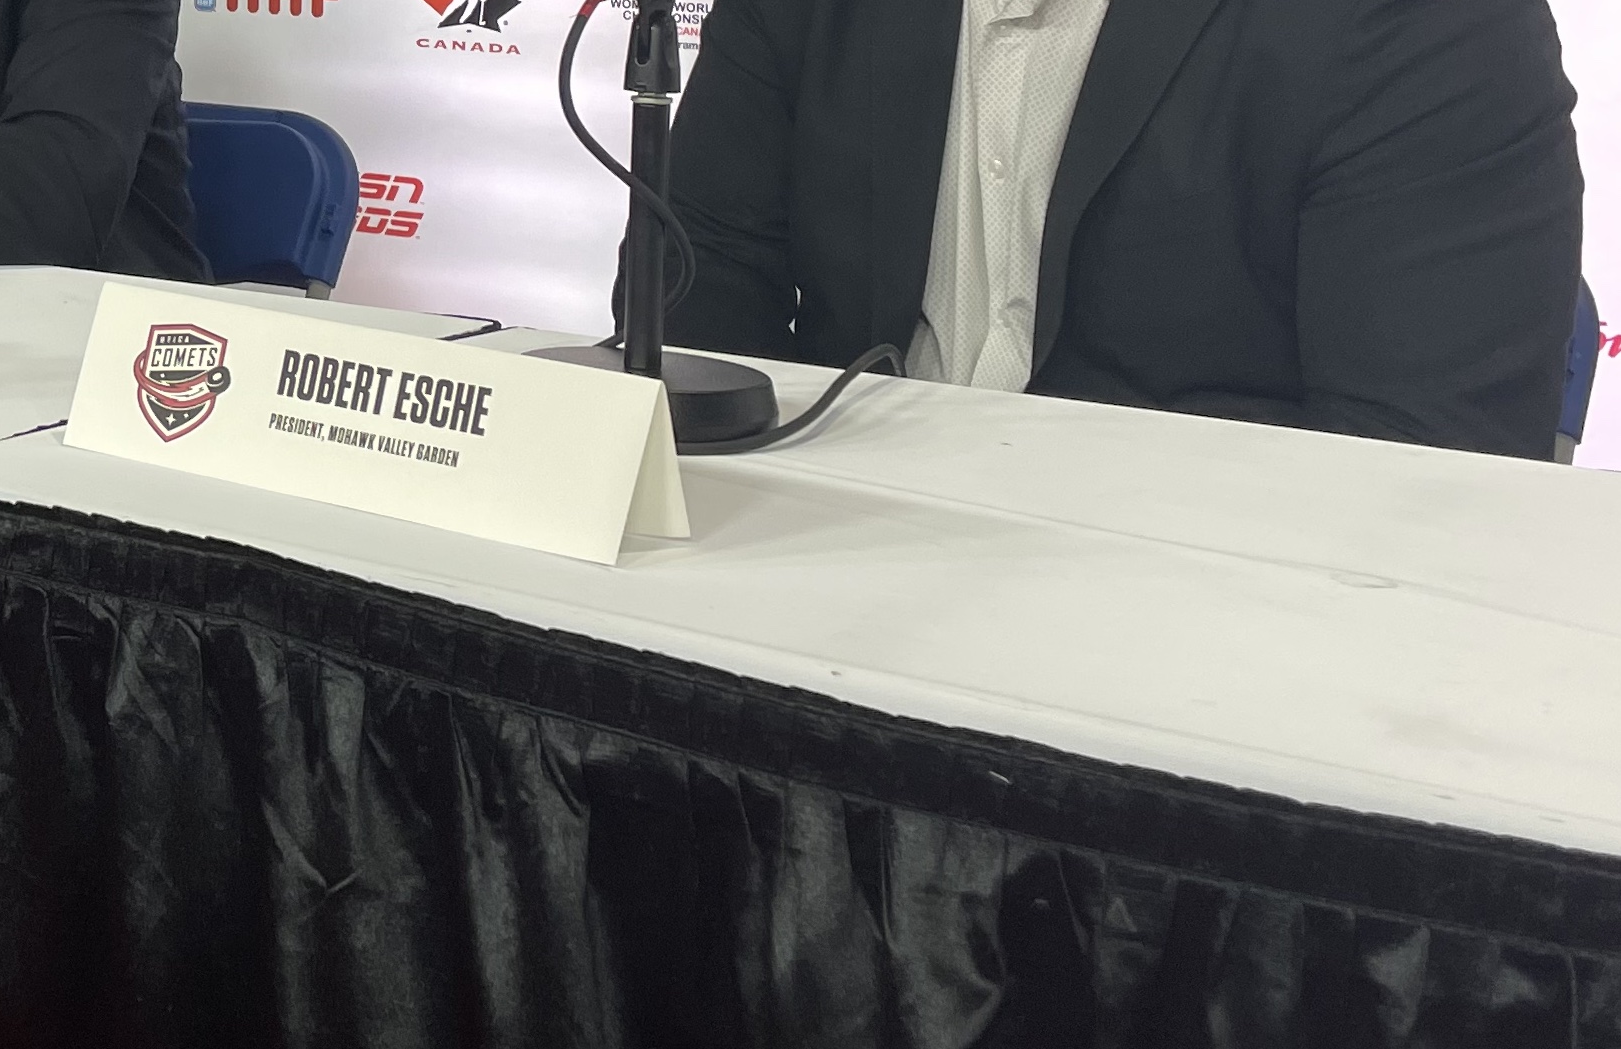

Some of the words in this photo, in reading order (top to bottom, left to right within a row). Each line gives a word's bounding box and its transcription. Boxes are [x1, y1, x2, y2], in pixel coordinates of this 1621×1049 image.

[416, 37, 521, 56] CANADA
[358, 172, 425, 204] SN
[356, 206, 425, 238] DS
[151, 347, 218, 367] COMETS
[277, 349, 393, 415] ROBERT
[393, 371, 493, 437] ESCHE
[268, 413, 325, 442] PRESIDENT,
[328, 425, 376, 451] MOHAWK
[377, 435, 415, 459] VALLEY
[416, 444, 460, 468] GARDEN
